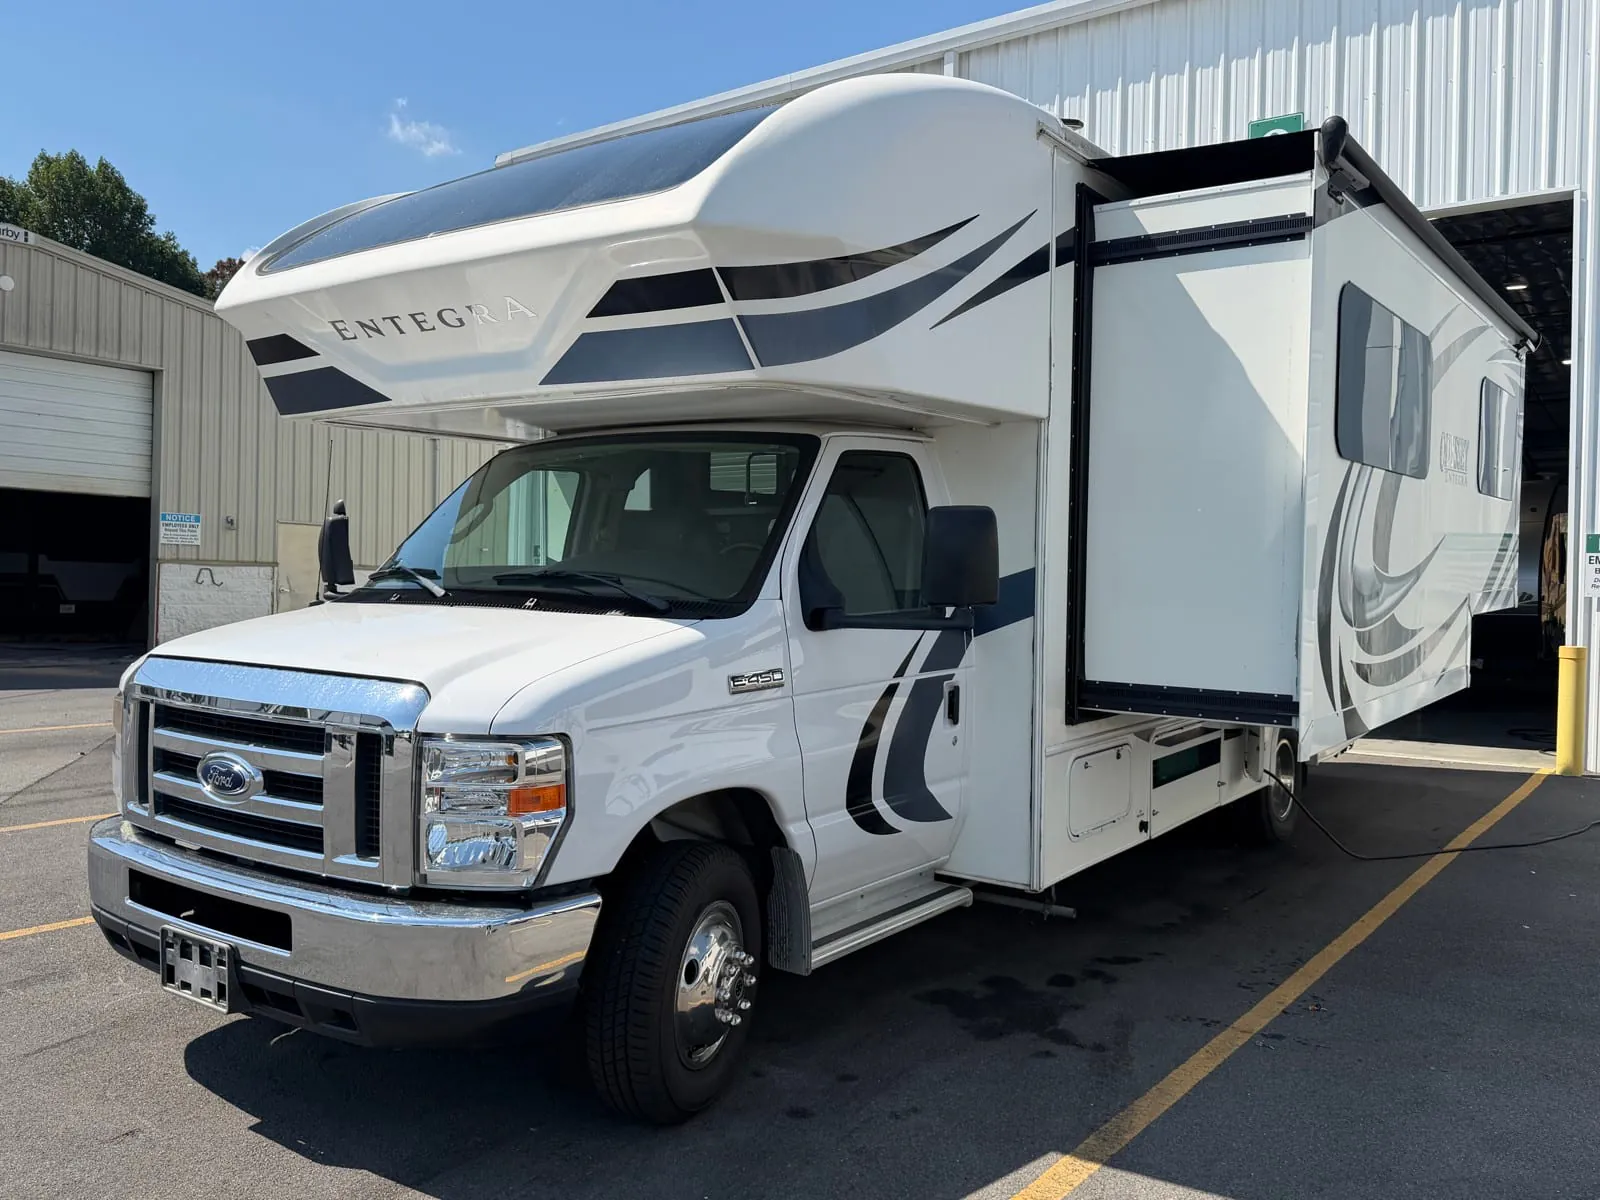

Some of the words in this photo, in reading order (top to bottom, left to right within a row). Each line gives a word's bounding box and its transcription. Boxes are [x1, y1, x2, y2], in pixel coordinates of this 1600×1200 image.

[328, 295, 538, 341] ENTEGRA
[166, 514, 196, 522] NOTICE
[207, 764, 234, 788] Ford
